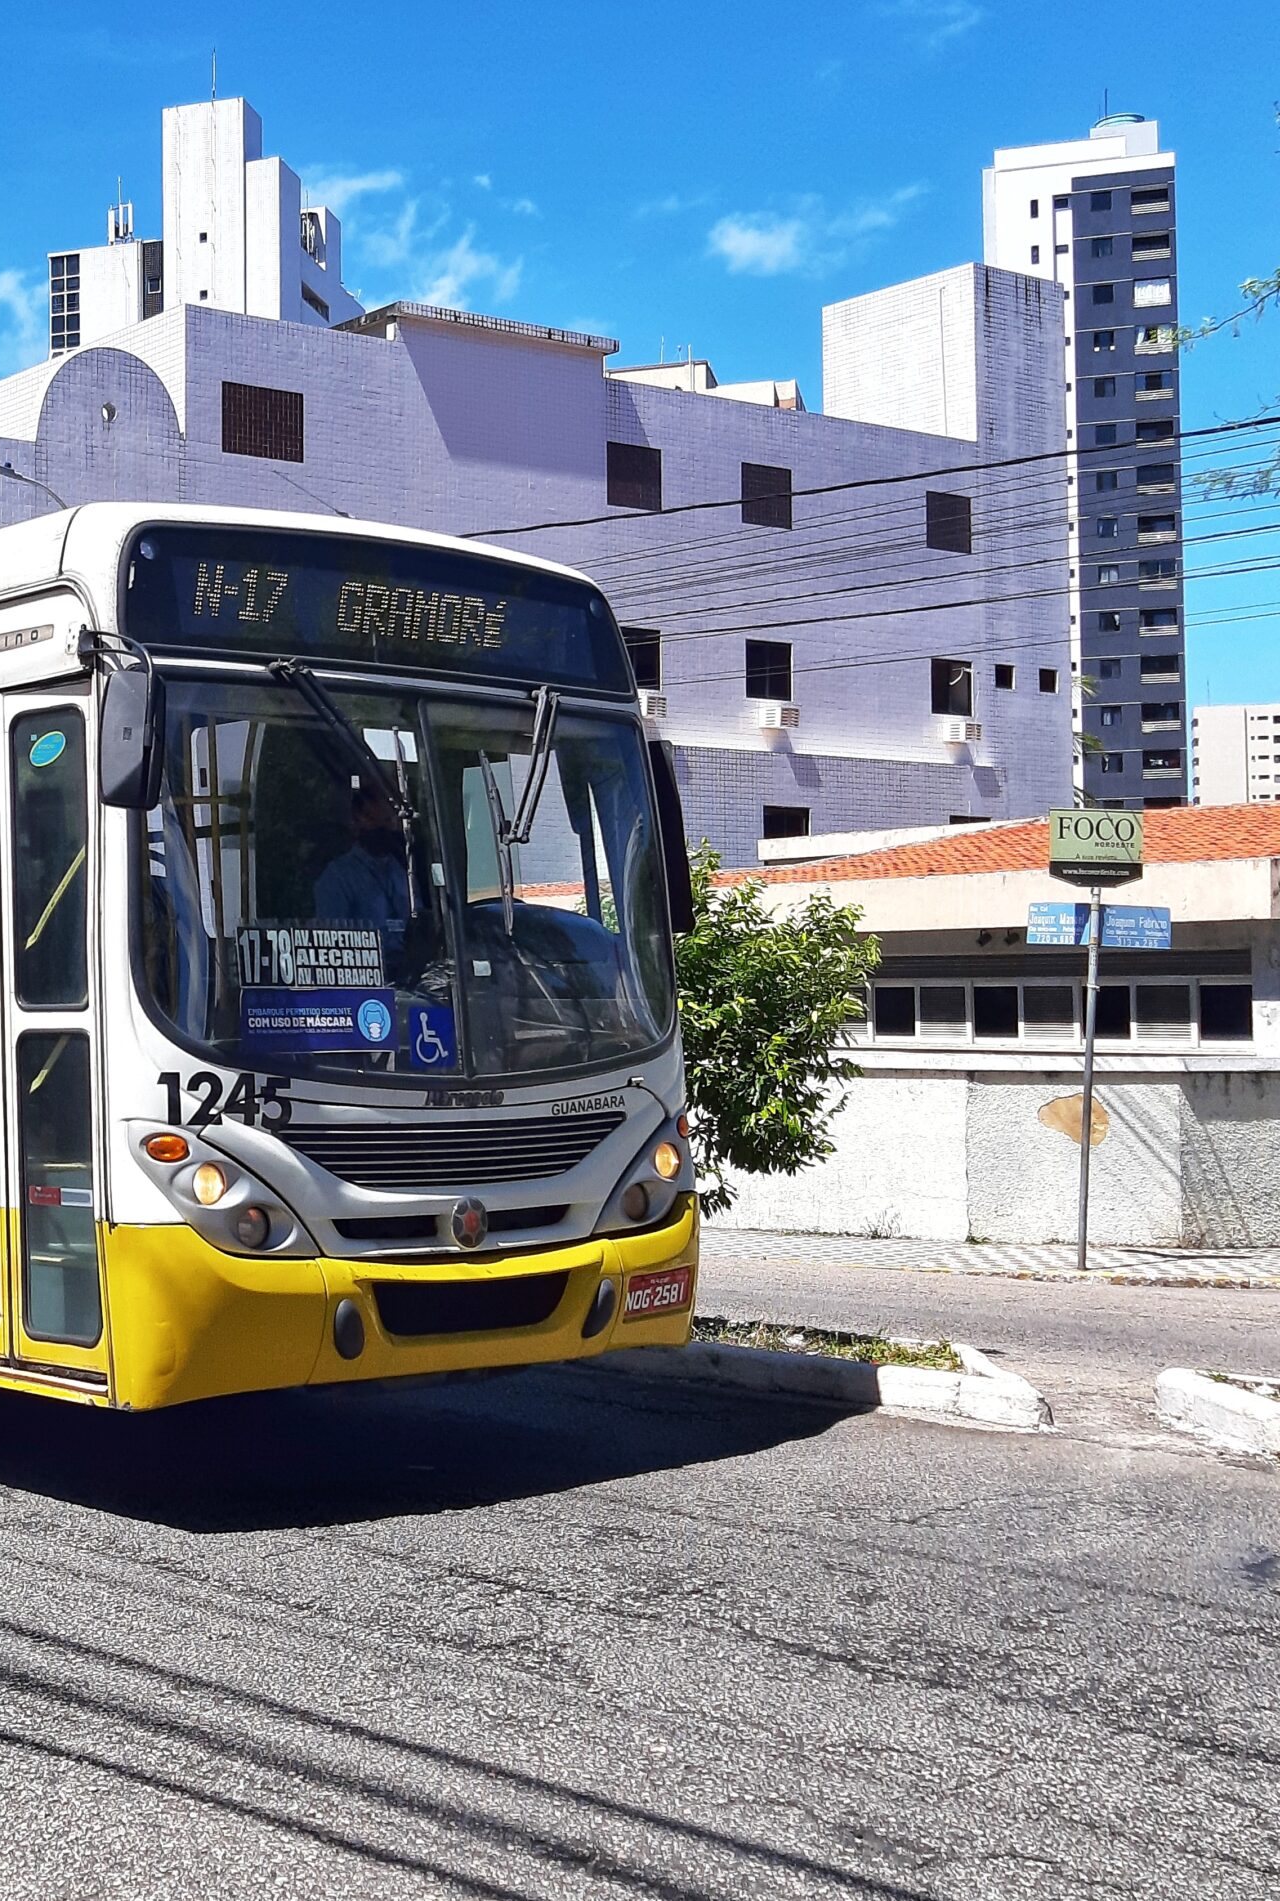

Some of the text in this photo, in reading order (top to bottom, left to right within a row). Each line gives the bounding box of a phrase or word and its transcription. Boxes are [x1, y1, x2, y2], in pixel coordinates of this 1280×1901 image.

[193, 562, 507, 649] N-17 GRAMORÉ
[1057, 815, 1135, 842] FOCO
[1094, 840, 1136, 849] NORDESTE
[1029, 912, 1056, 927] Joaquim
[1105, 915, 1136, 930] Joaquim
[294, 930, 377, 948] AV. ITAPETINGA
[1036, 934, 1051, 943] 720
[239, 929, 294, 984] 17-78
[297, 948, 379, 967] ALECRIM
[298, 967, 381, 986] AV. RIO BRANCO
[248, 1015, 353, 1027] COM USO DE MÁSCARA
[321, 1008, 352, 1016] SOMENTE
[157, 1071, 293, 1130] 1245
[551, 1095, 626, 1116] GUANABARA
